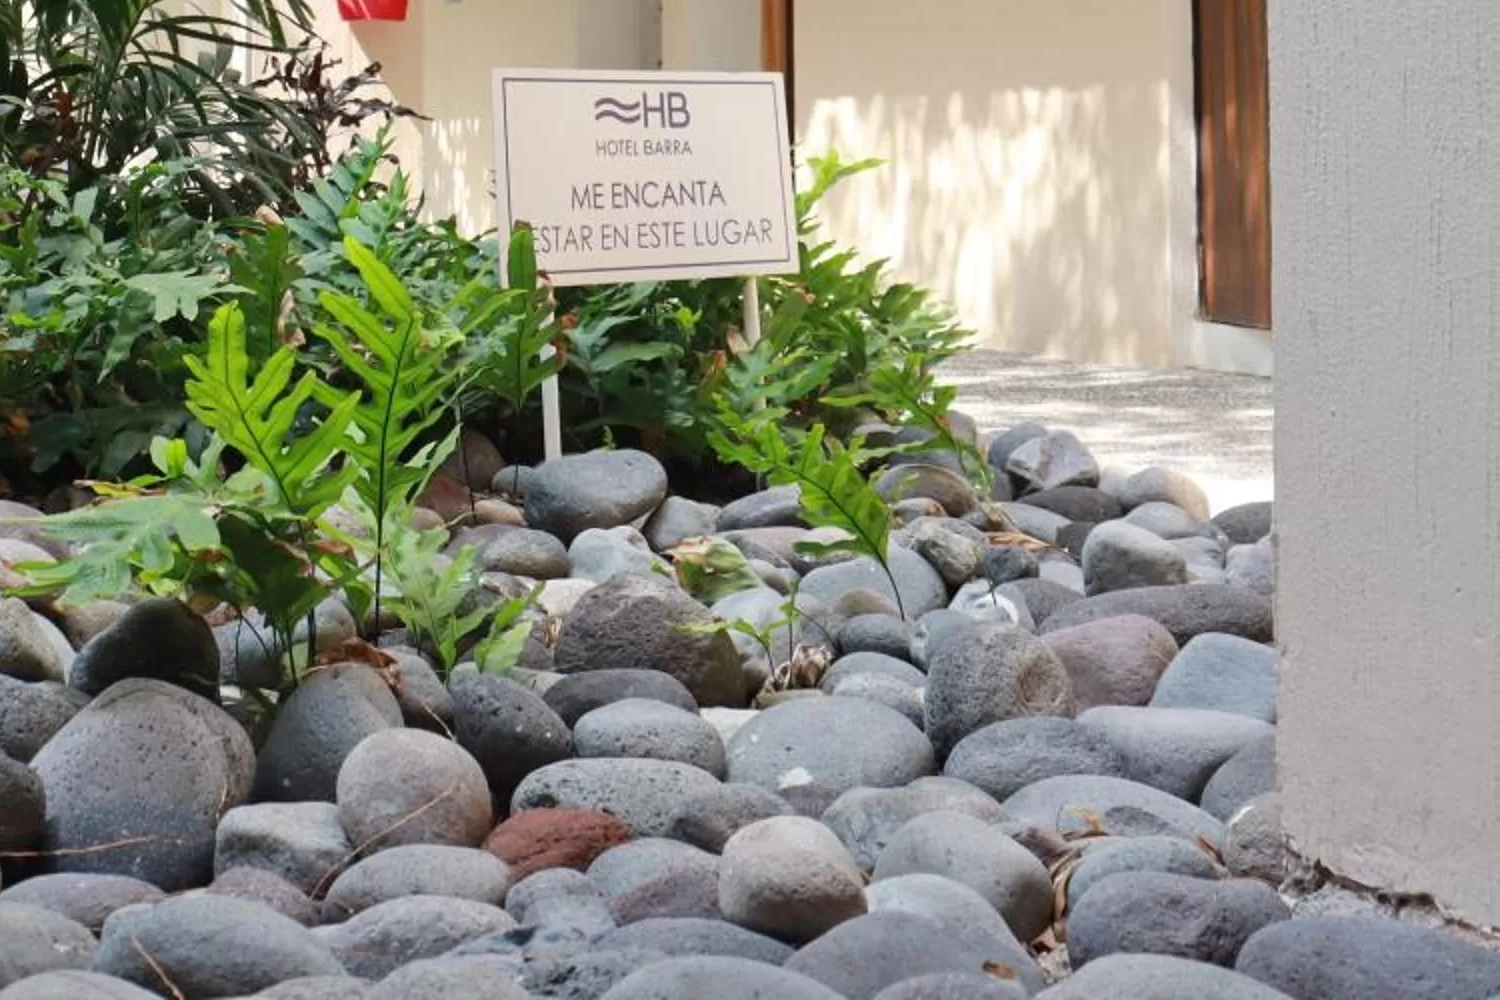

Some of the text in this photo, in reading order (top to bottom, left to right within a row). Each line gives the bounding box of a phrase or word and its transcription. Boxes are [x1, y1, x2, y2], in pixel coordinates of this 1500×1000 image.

[642, 91, 691, 128] HB
[595, 138, 692, 157] HOTEL BARRA
[571, 180, 727, 210] ME ENCANTA
[601, 223, 629, 250] EN
[637, 221, 685, 249] ESTE
[693, 218, 773, 247] LUGAR
